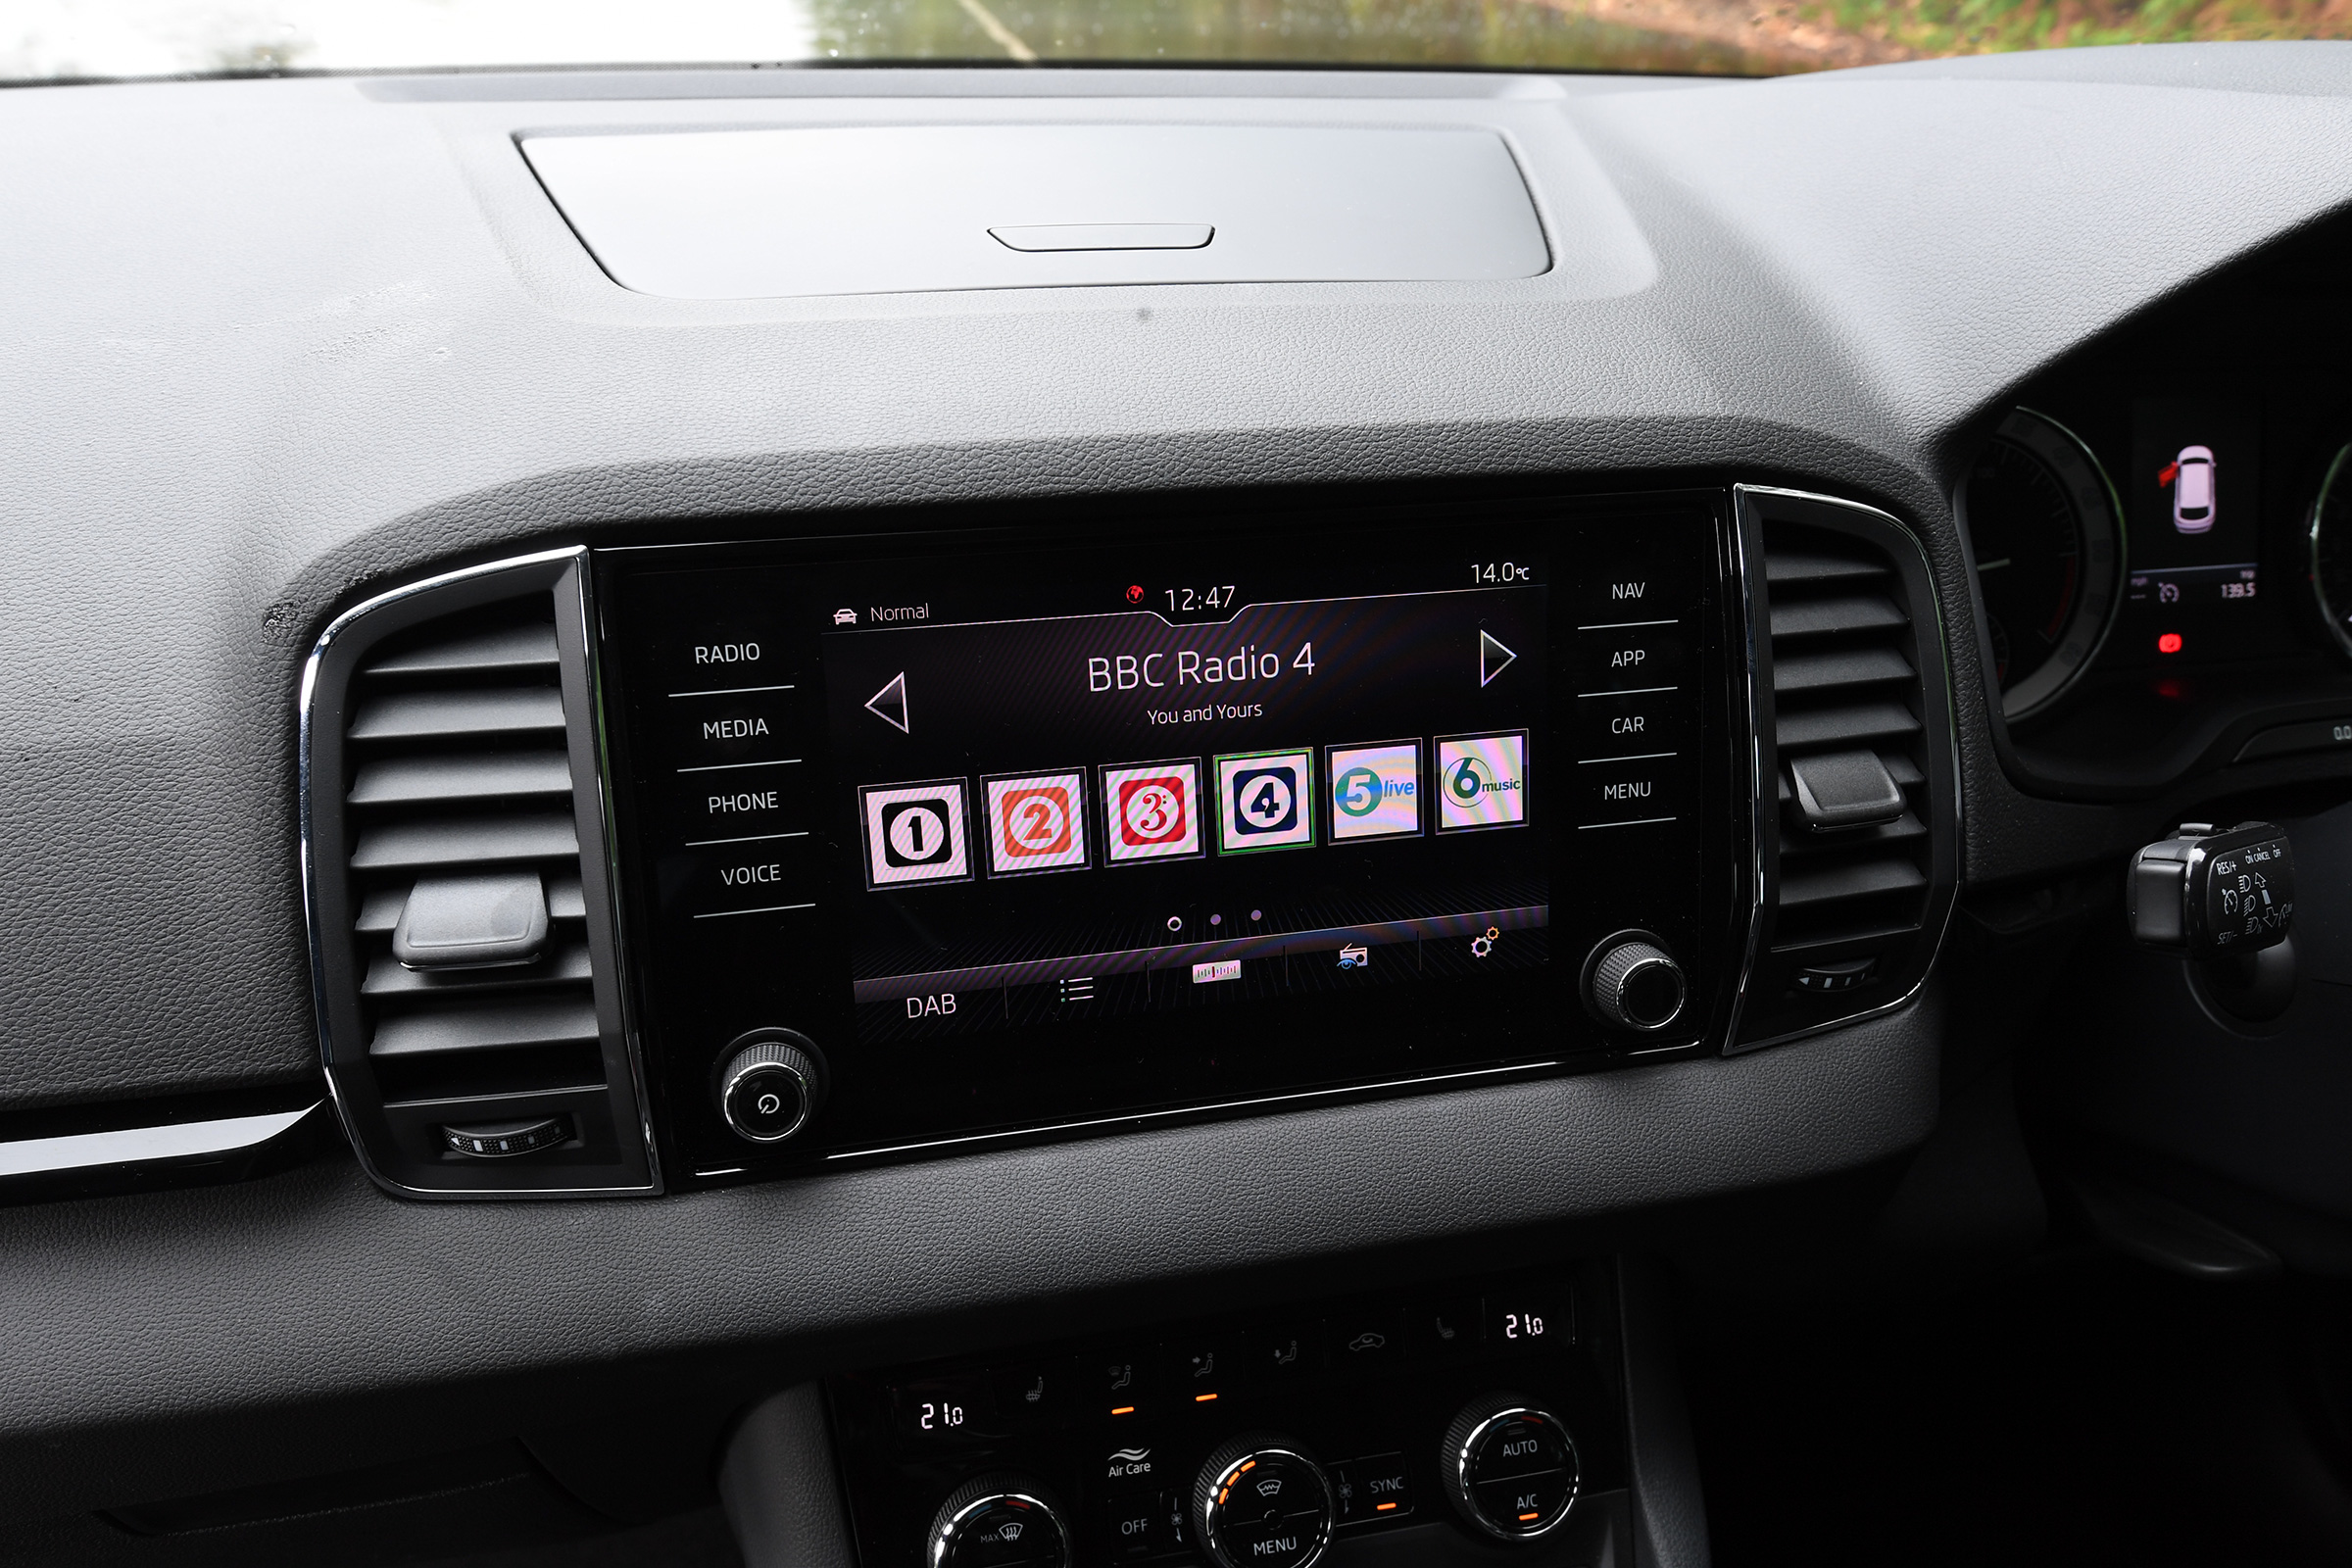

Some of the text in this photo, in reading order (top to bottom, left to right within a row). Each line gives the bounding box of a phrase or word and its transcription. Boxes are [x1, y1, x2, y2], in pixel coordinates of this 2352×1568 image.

[1164, 585, 1236, 612] 12:47
[1612, 581, 1645, 600] NAV
[2221, 582, 2256, 599] 139.5
[870, 602, 930, 622] Normal
[694, 642, 760, 664] RADIO
[1611, 649, 1645, 667] APP
[1088, 641, 1316, 692] BBC Radio 4
[1147, 704, 1263, 725] You and Yours
[1611, 715, 1644, 734] CAR
[703, 717, 769, 740] MEDIA
[1451, 757, 1522, 800] 6 music
[1249, 782, 1281, 819] 4
[1344, 773, 1416, 811] 5 live
[1604, 781, 1651, 801] MENU
[708, 791, 779, 814] PHONE
[1022, 802, 1054, 842] 2
[906, 814, 926, 854] 1
[2254, 852, 2271, 862] CANCEL
[720, 863, 782, 886] VOICE
[906, 993, 956, 1019] DAB
[1505, 1313, 1544, 1339] 21.0
[920, 1402, 963, 1430] 21.0
[1502, 1439, 1538, 1457] AUTO
[1107, 1460, 1152, 1478] Air Care
[1369, 1476, 1404, 1494] SYNC
[1516, 1494, 1539, 1510] A/C
[1121, 1518, 1148, 1536] OFF
[981, 1534, 999, 1543] MAX
[1253, 1536, 1298, 1556] MENU
